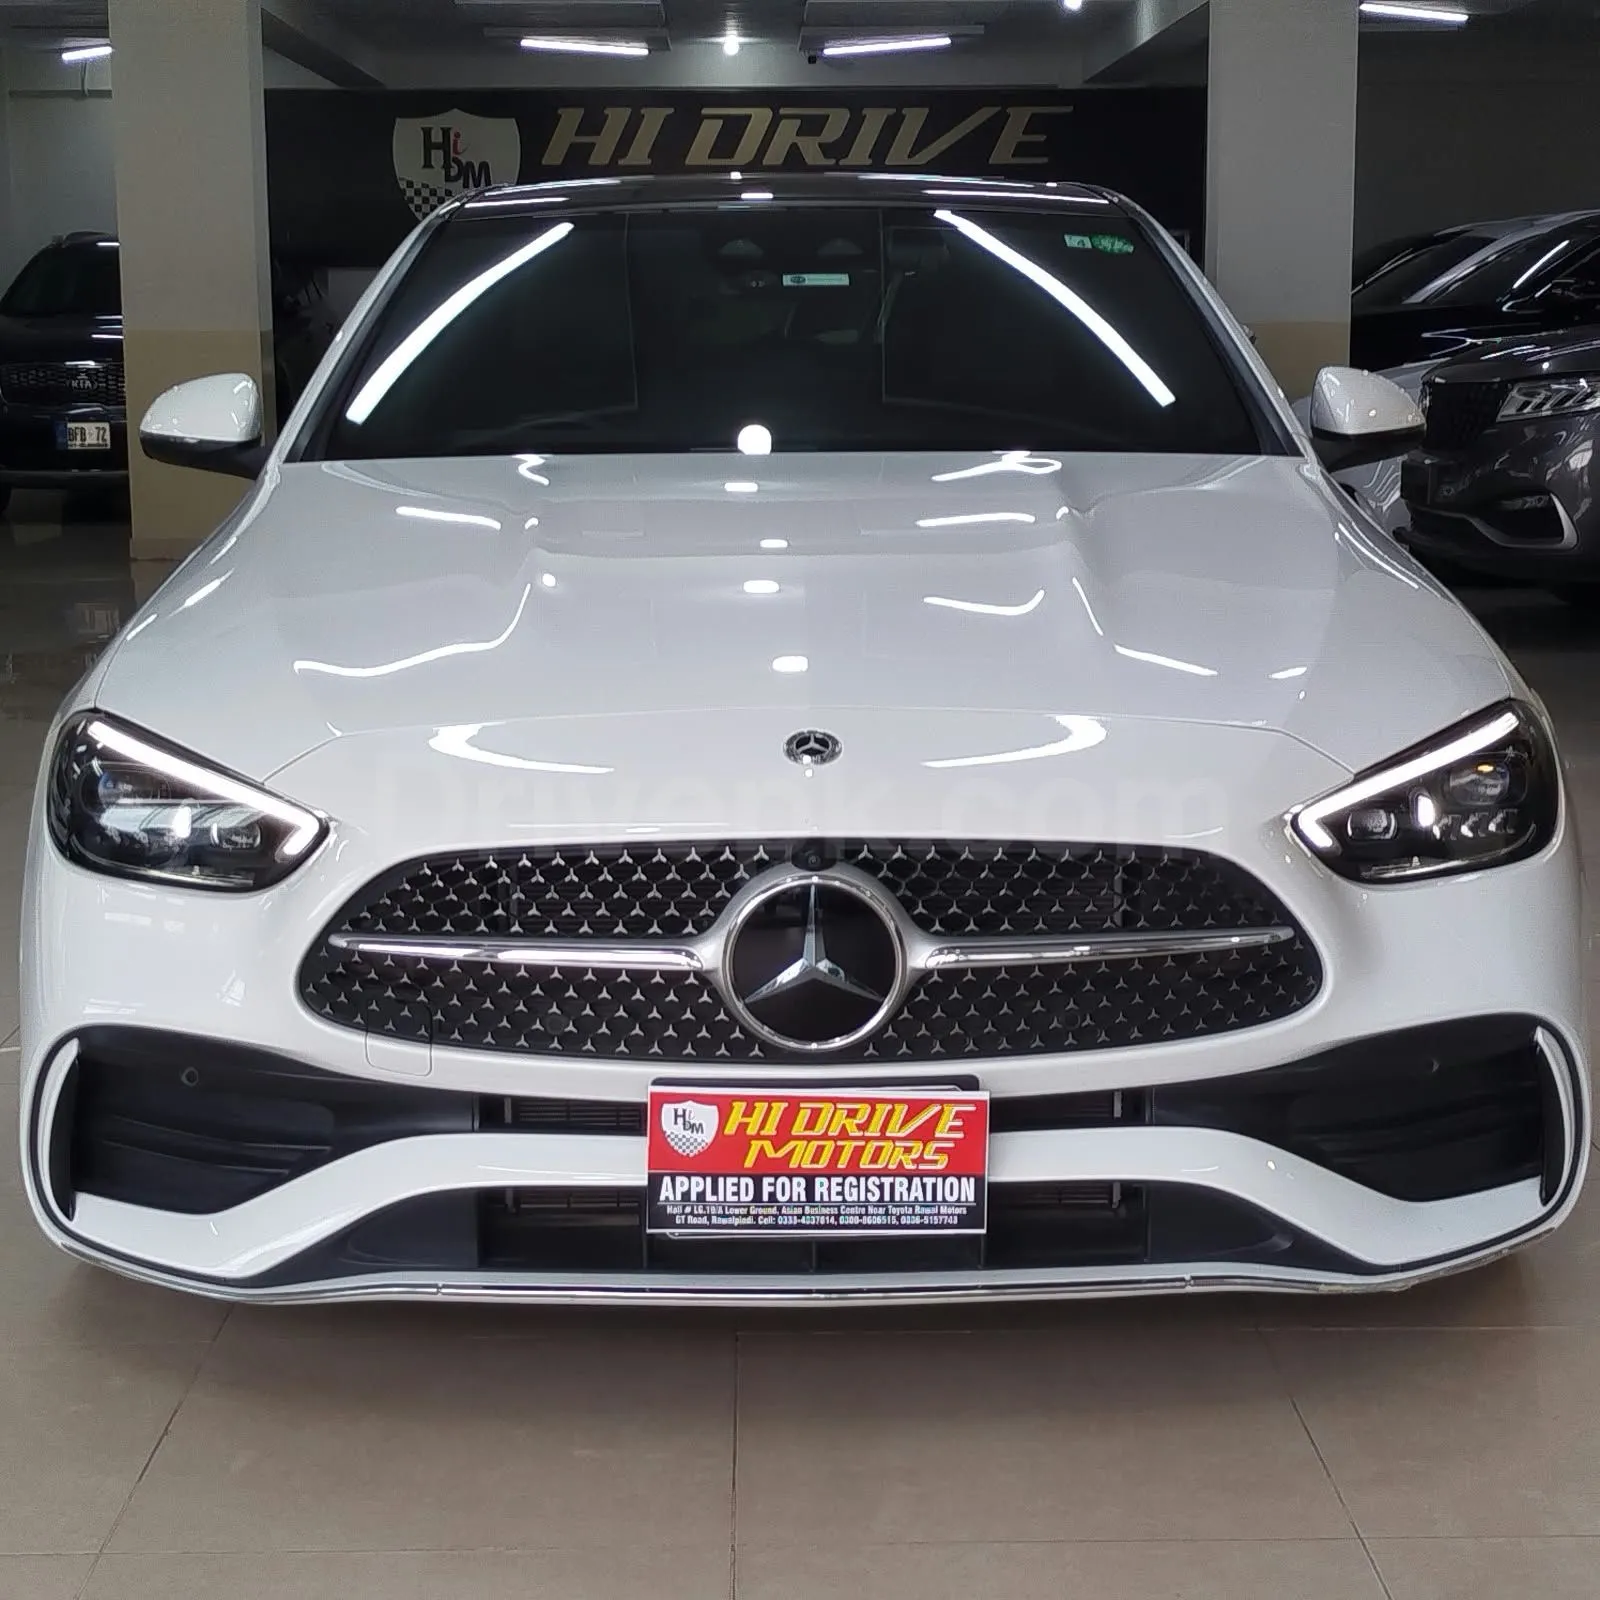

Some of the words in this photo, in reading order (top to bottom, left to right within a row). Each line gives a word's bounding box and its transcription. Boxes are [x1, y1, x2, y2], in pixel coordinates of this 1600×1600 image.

[541, 107, 674, 165] HI
[685, 106, 1074, 165] DRIVE
[724, 1101, 788, 1136] HI
[791, 1102, 977, 1139] DRIVE
[744, 1140, 955, 1170] MOTORS
[660, 1176, 755, 1202] APPLIED
[762, 1177, 807, 1202] FOR
[815, 1177, 976, 1203] REGISTRATION
[725, 1206, 748, 1214] Lower
[804, 1206, 839, 1215] Business
[888, 1206, 913, 1216] Toyota
[940, 1206, 968, 1215] Motors
